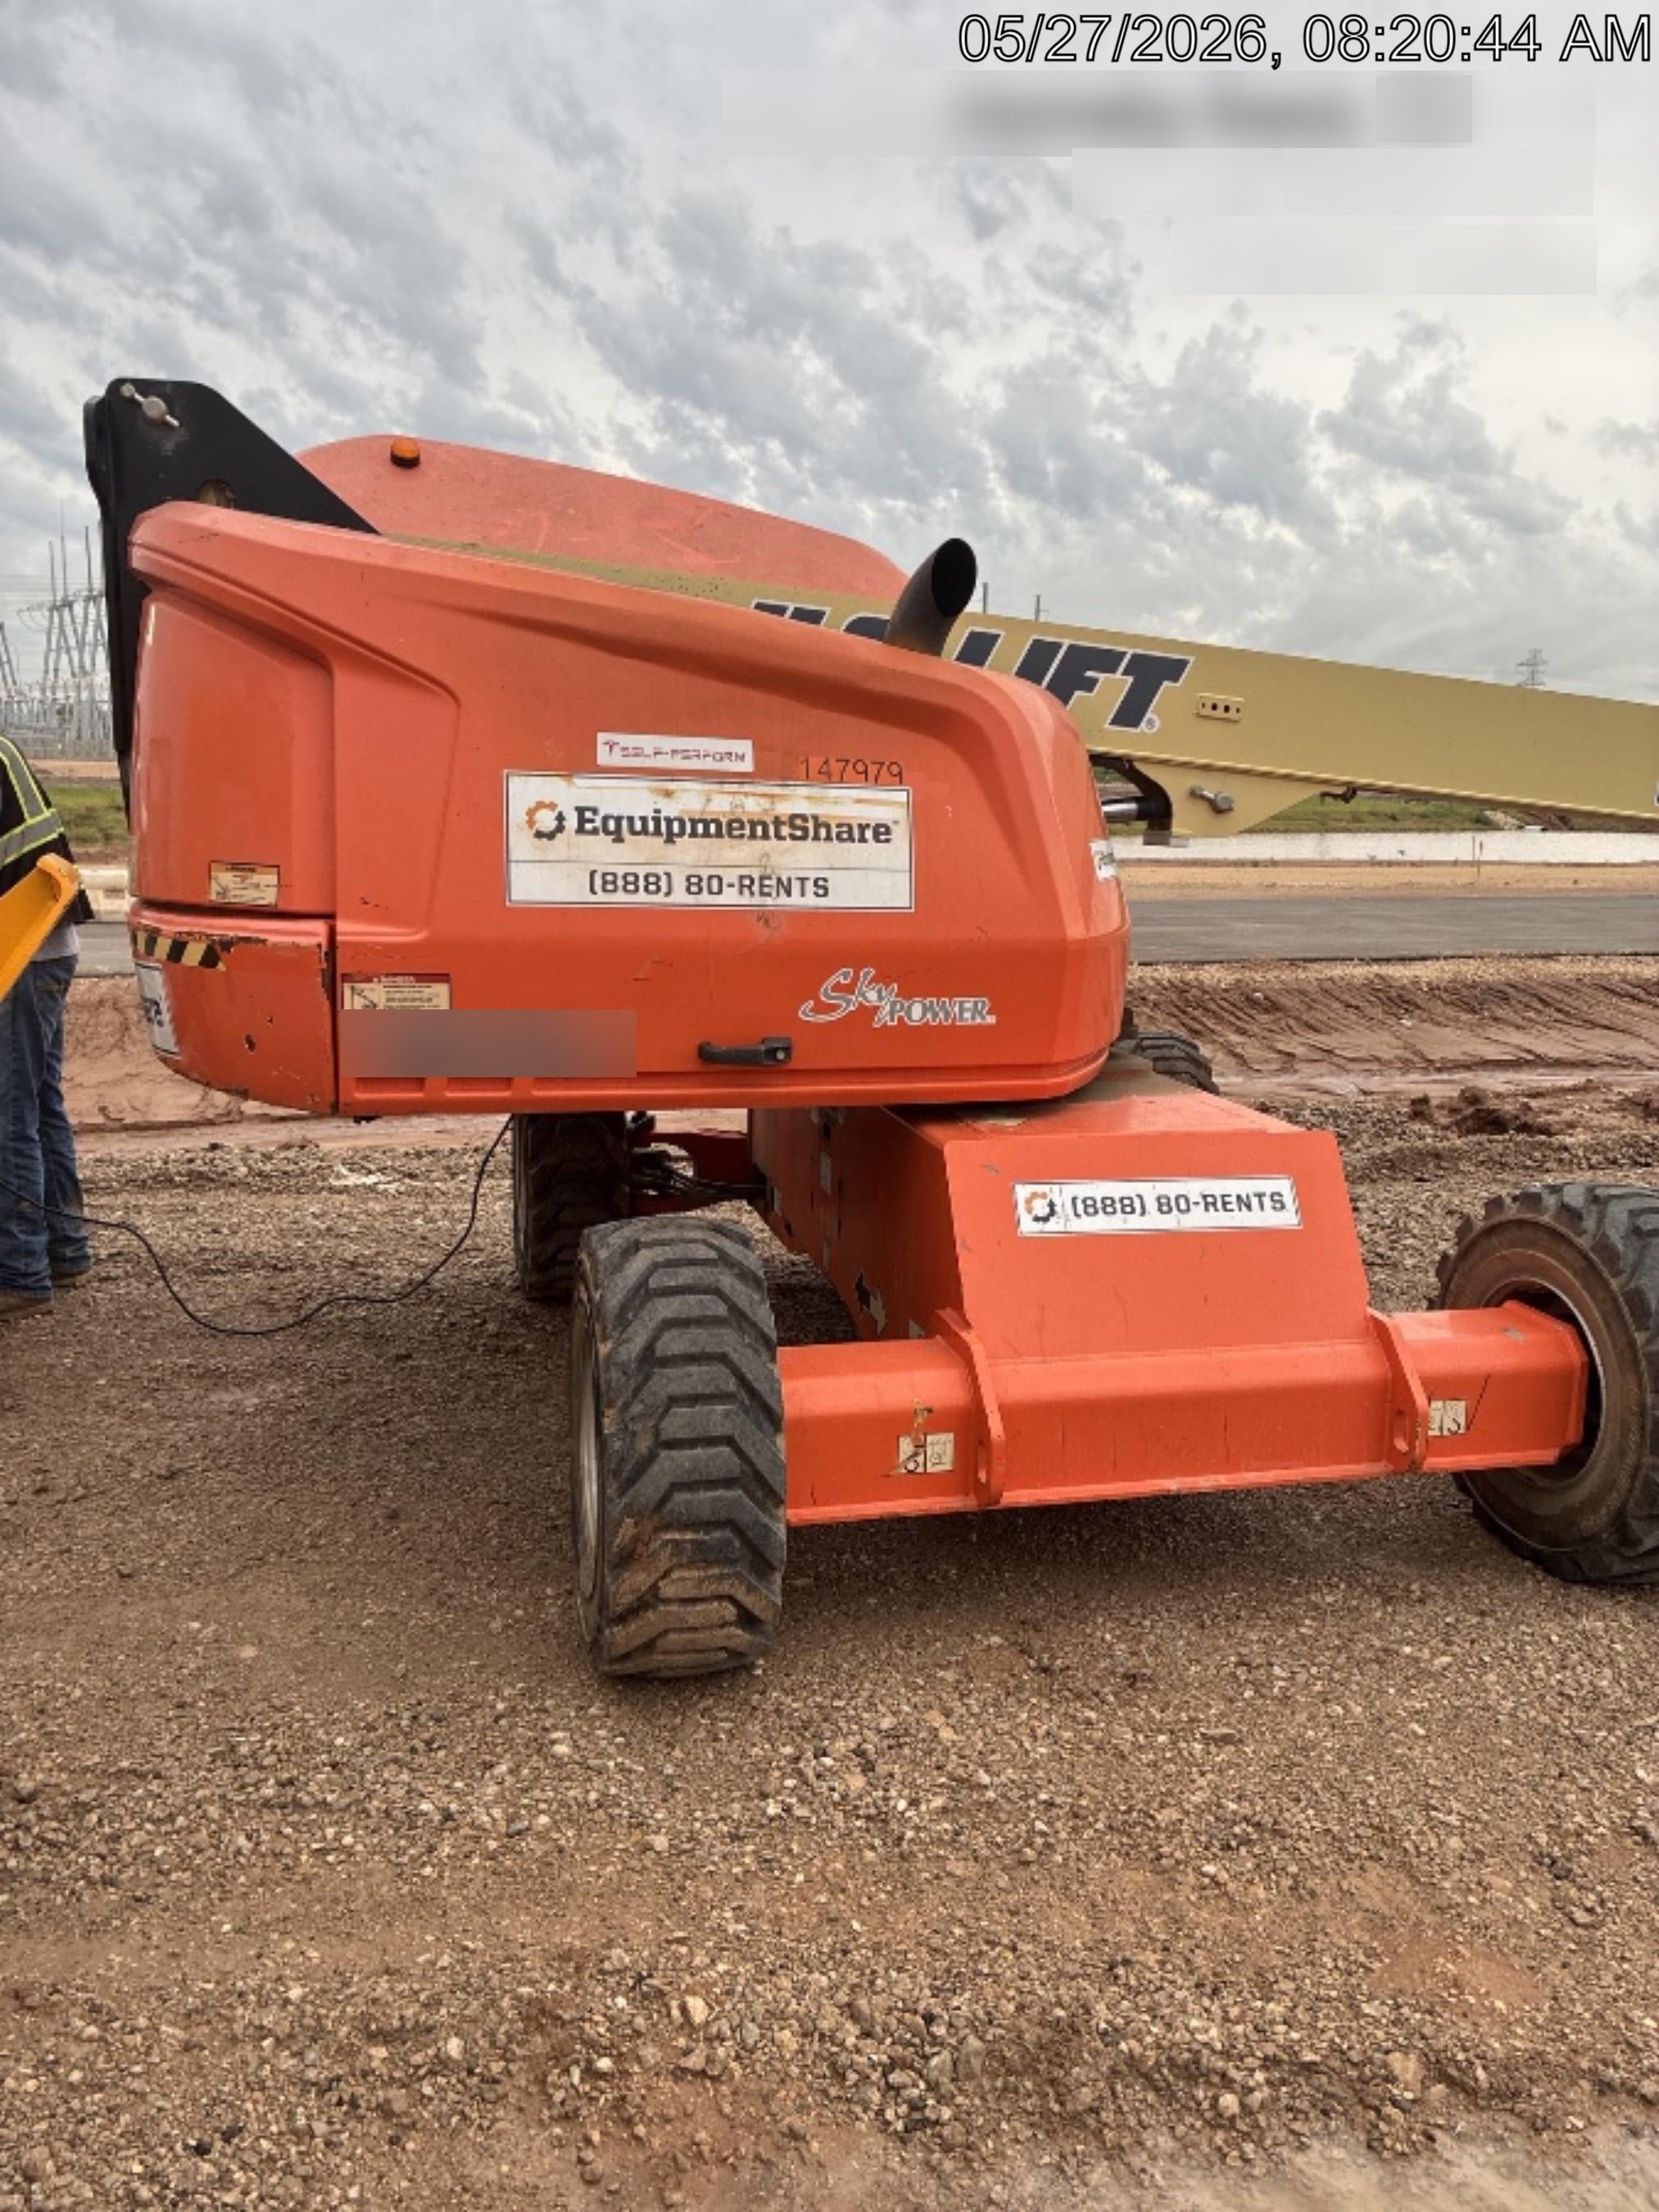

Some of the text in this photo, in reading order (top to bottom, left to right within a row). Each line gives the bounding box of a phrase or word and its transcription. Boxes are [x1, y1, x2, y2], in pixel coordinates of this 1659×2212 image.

[800, 757, 904, 784] 147979
[574, 806, 892, 844] EquipmentShare
[589, 870, 830, 899] (888) 80-RENTS
[1072, 1192, 1286, 1218] (888) 80-RENTS
